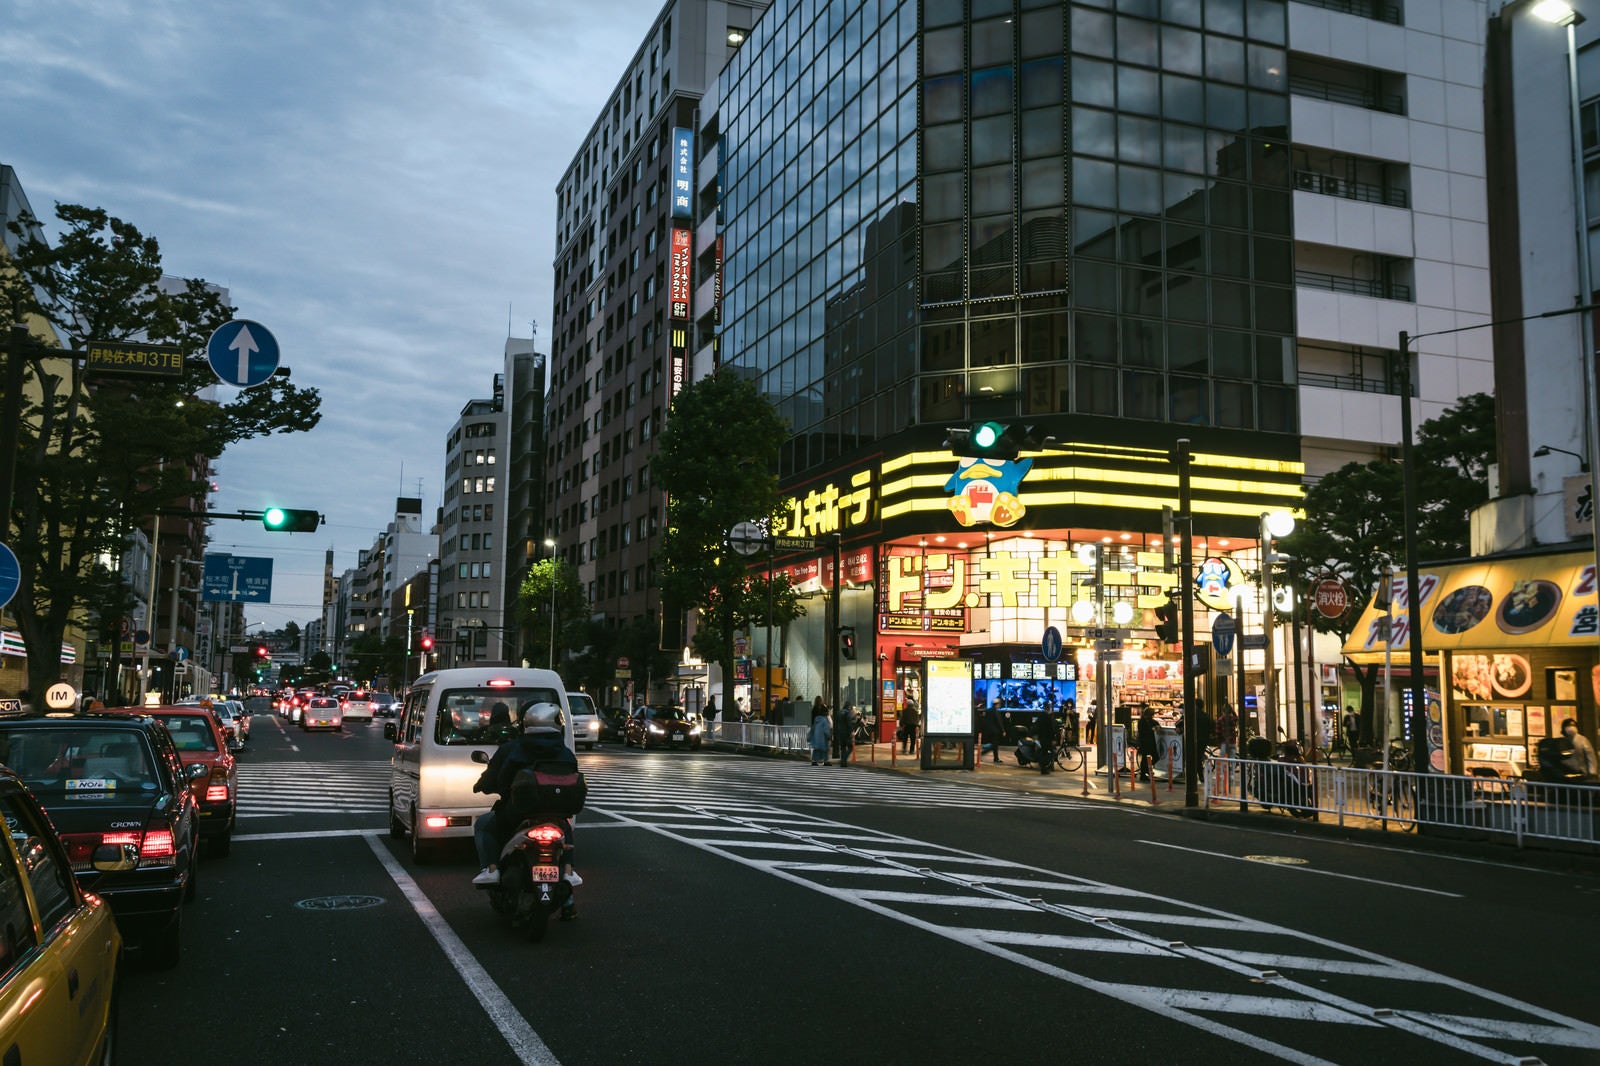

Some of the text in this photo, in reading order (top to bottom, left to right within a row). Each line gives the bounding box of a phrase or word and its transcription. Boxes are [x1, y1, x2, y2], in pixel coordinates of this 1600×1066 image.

[90, 348, 182, 368] 伊勢佐木町3丁目
[1318, 591, 1344, 606] 消火栓
[111, 821, 142, 829] CROWN
